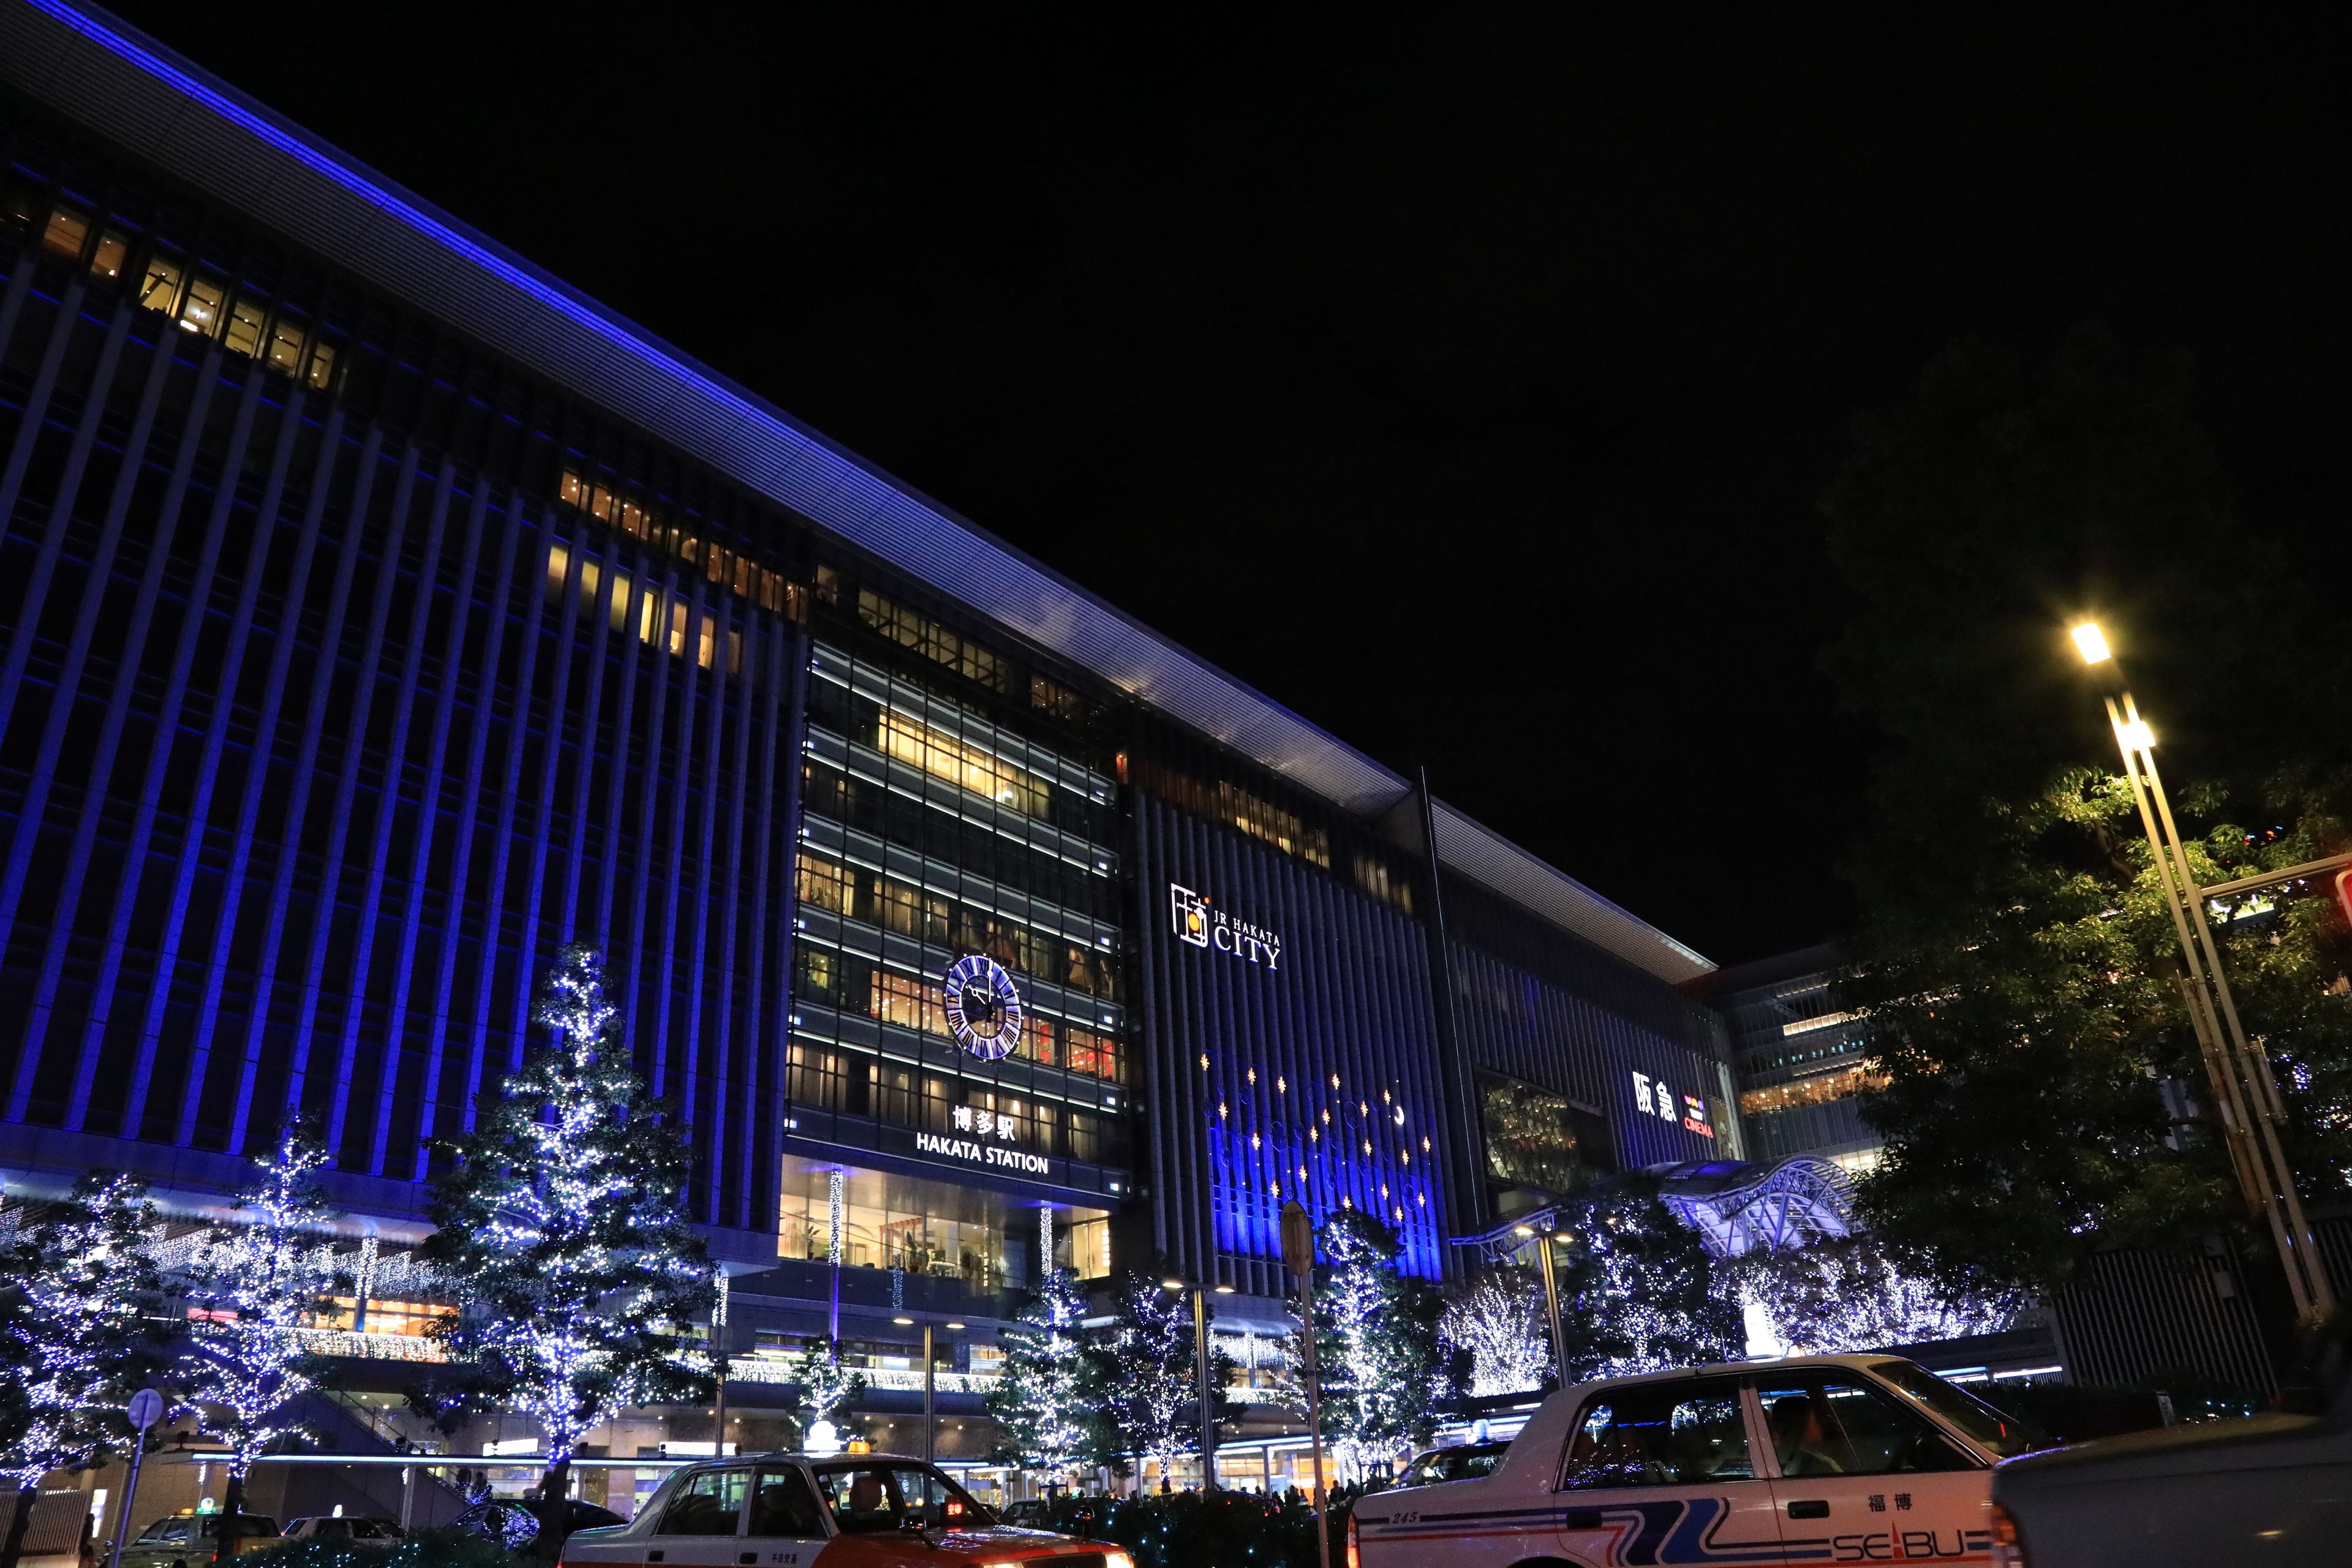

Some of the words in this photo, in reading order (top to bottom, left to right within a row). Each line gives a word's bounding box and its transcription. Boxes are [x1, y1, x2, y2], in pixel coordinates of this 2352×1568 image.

[1214, 910, 1227, 925] JR
[1234, 918, 1280, 946] HAKATA
[1215, 925, 1280, 970] CITY
[1632, 1071, 1677, 1122] 阪急
[952, 1105, 1016, 1142] 博多駅
[1684, 1117, 1714, 1138] CINEMA
[917, 1133, 981, 1161] HAKATA
[986, 1147, 1048, 1174] STATION
[1392, 1512, 1418, 1524] 245
[1868, 1493, 1913, 1512] 福博
[1833, 1520, 1964, 1561] SEIBU
